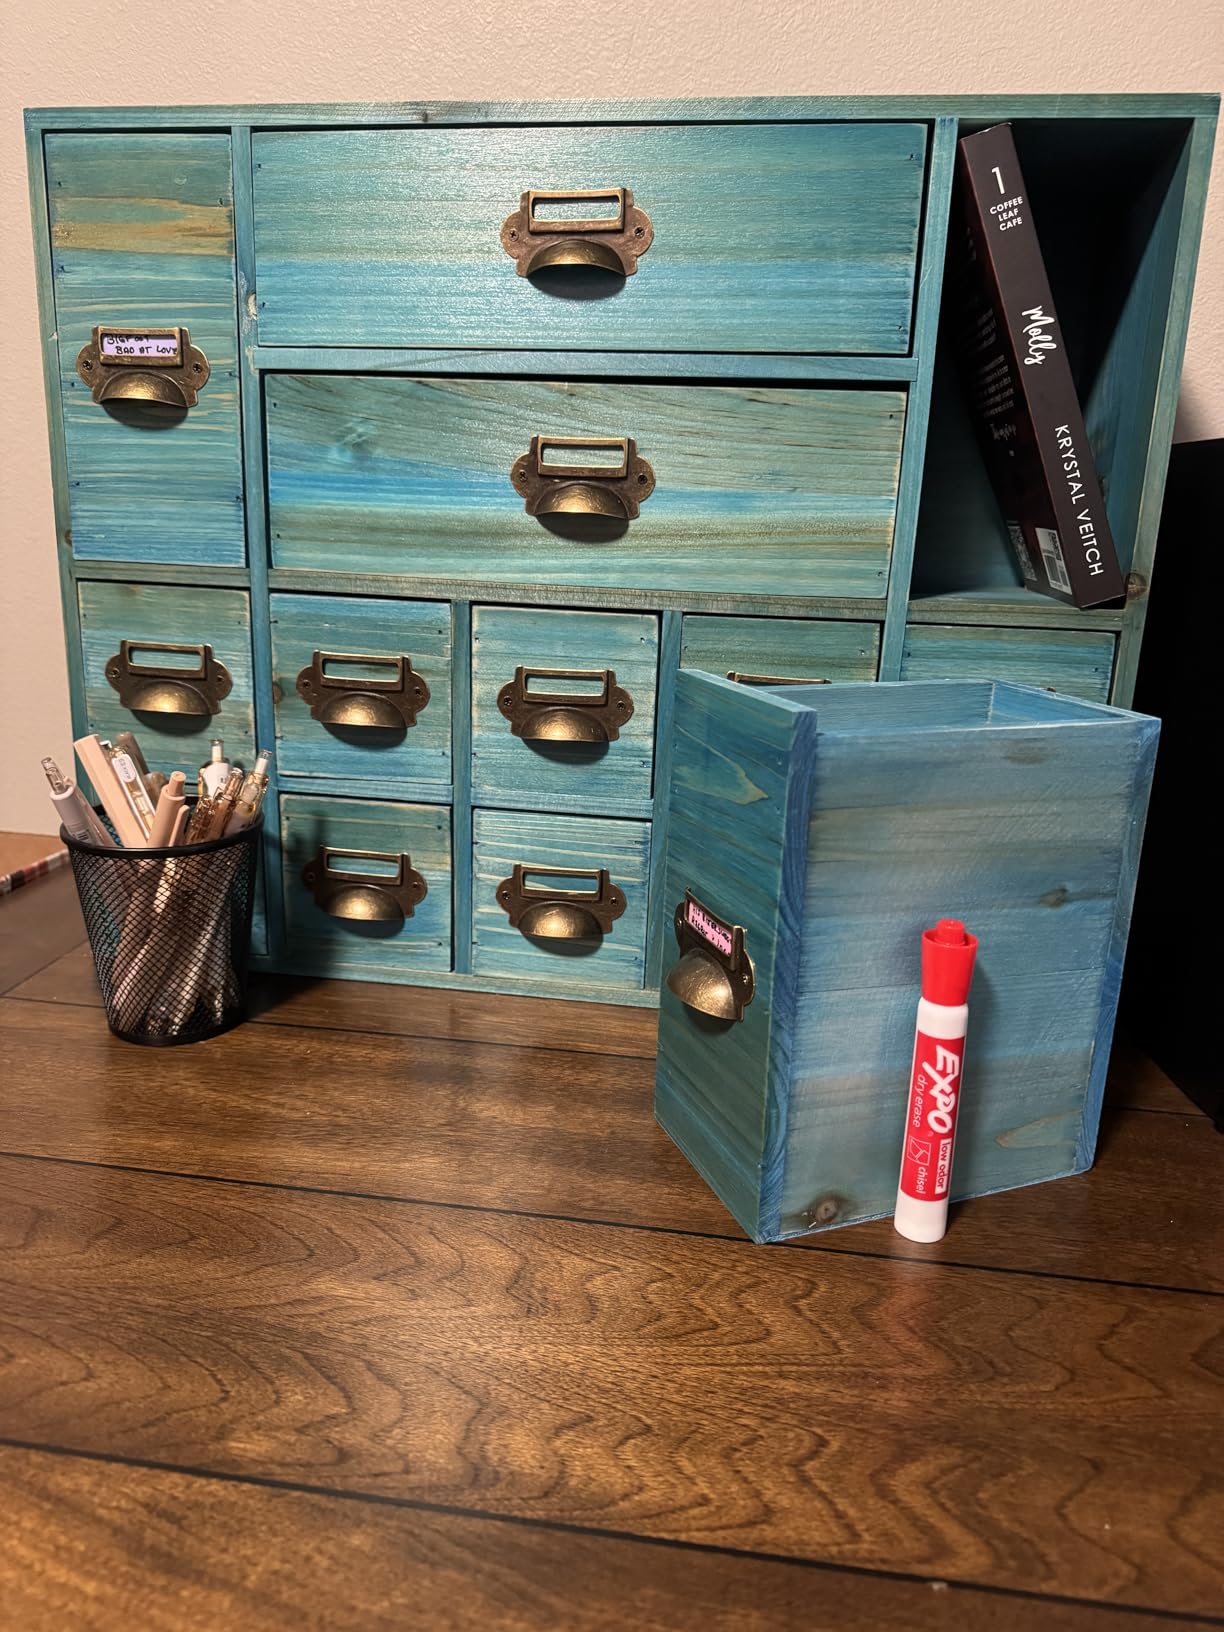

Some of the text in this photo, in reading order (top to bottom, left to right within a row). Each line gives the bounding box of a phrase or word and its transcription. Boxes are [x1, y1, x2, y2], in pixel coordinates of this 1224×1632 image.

[991, 166, 1005, 195] 1
[989, 196, 1024, 215] COFFEE
[998, 208, 1019, 222] LEAF
[999, 216, 1023, 231] CAFE
[1021, 305, 1057, 365] Molly
[1055, 424, 1086, 505] KRYSTAL
[1076, 508, 1104, 576] VEITCH
[912, 1073, 929, 1128] dry erase
[921, 1044, 960, 1135] EXPO
[916, 1166, 929, 1195] chisel
[935, 1141, 951, 1189] low odor
